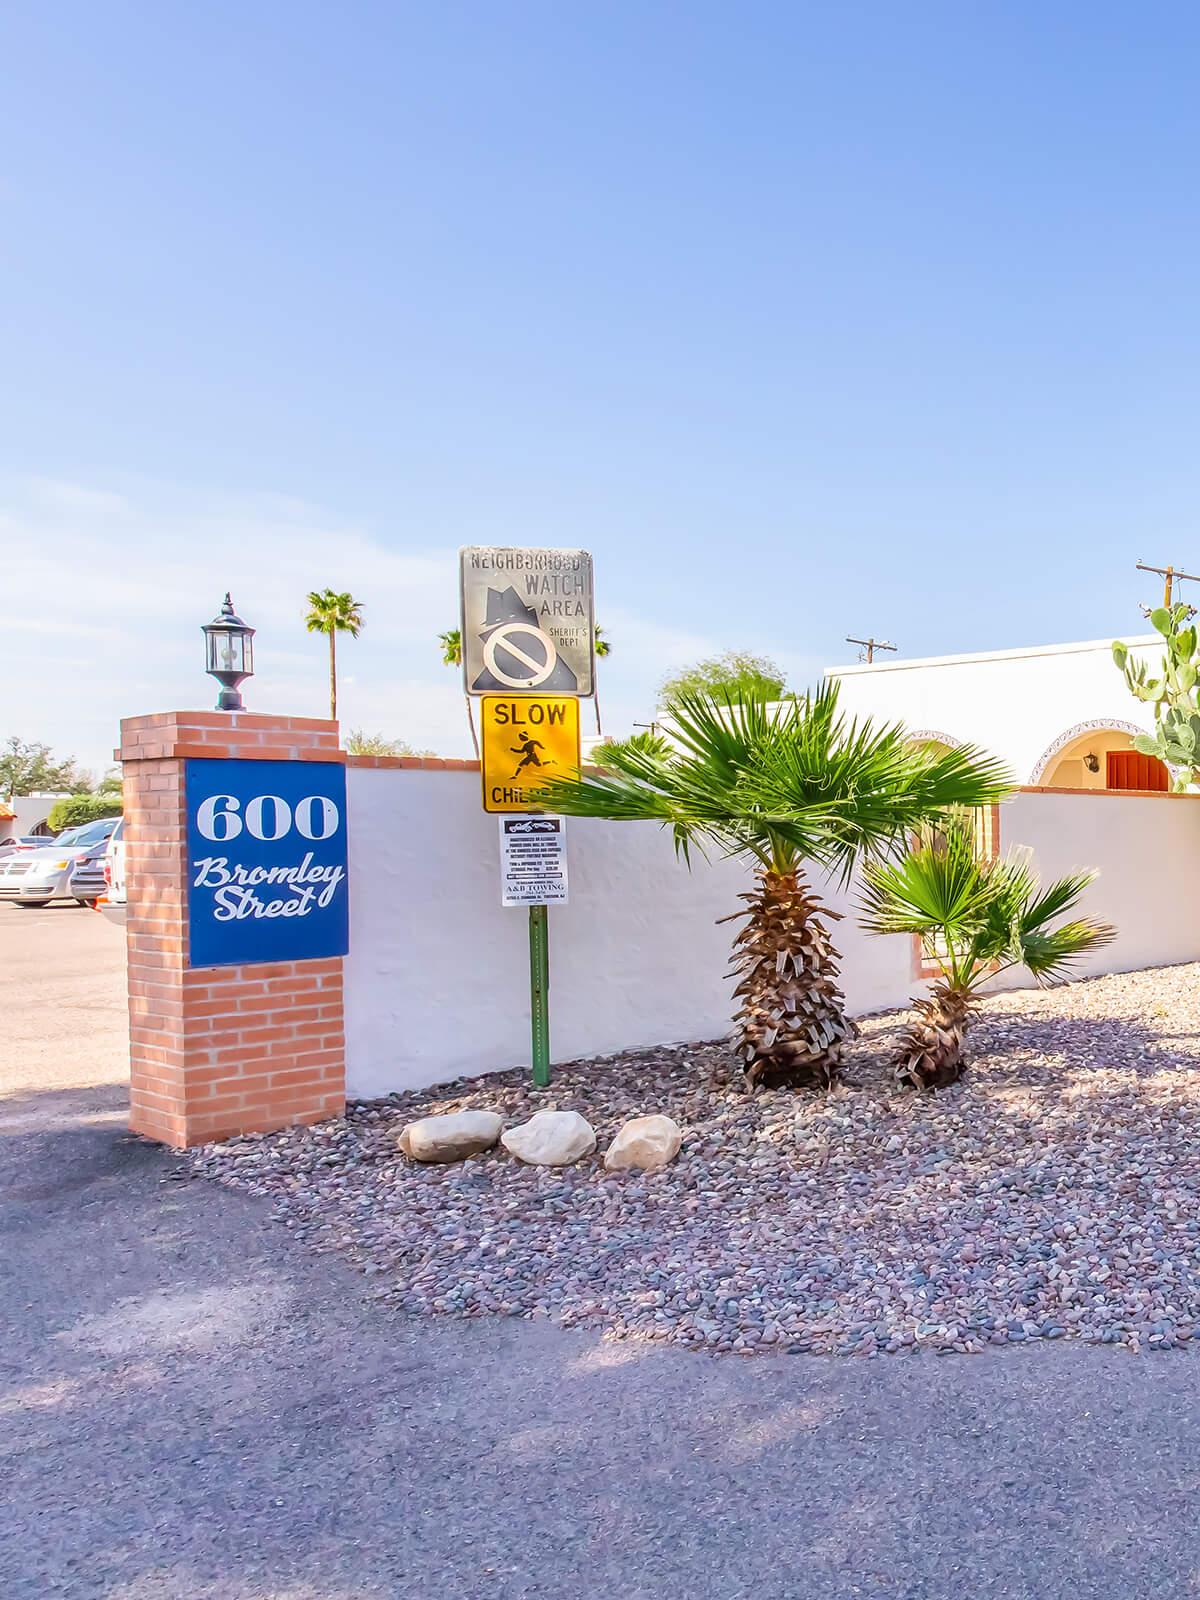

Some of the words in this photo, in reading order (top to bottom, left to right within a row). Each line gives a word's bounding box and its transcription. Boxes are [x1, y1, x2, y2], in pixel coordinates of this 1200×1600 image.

[471, 552, 581, 571] NEIGHBORHOOD
[525, 574, 584, 596] WATCH
[540, 599, 585, 617] AREA
[494, 703, 566, 725] SLOW
[492, 786, 563, 804] CHIL
[197, 794, 339, 842] 600
[193, 852, 346, 908] Bromley
[528, 883, 564, 891] TOWING
[213, 885, 317, 922] Street
